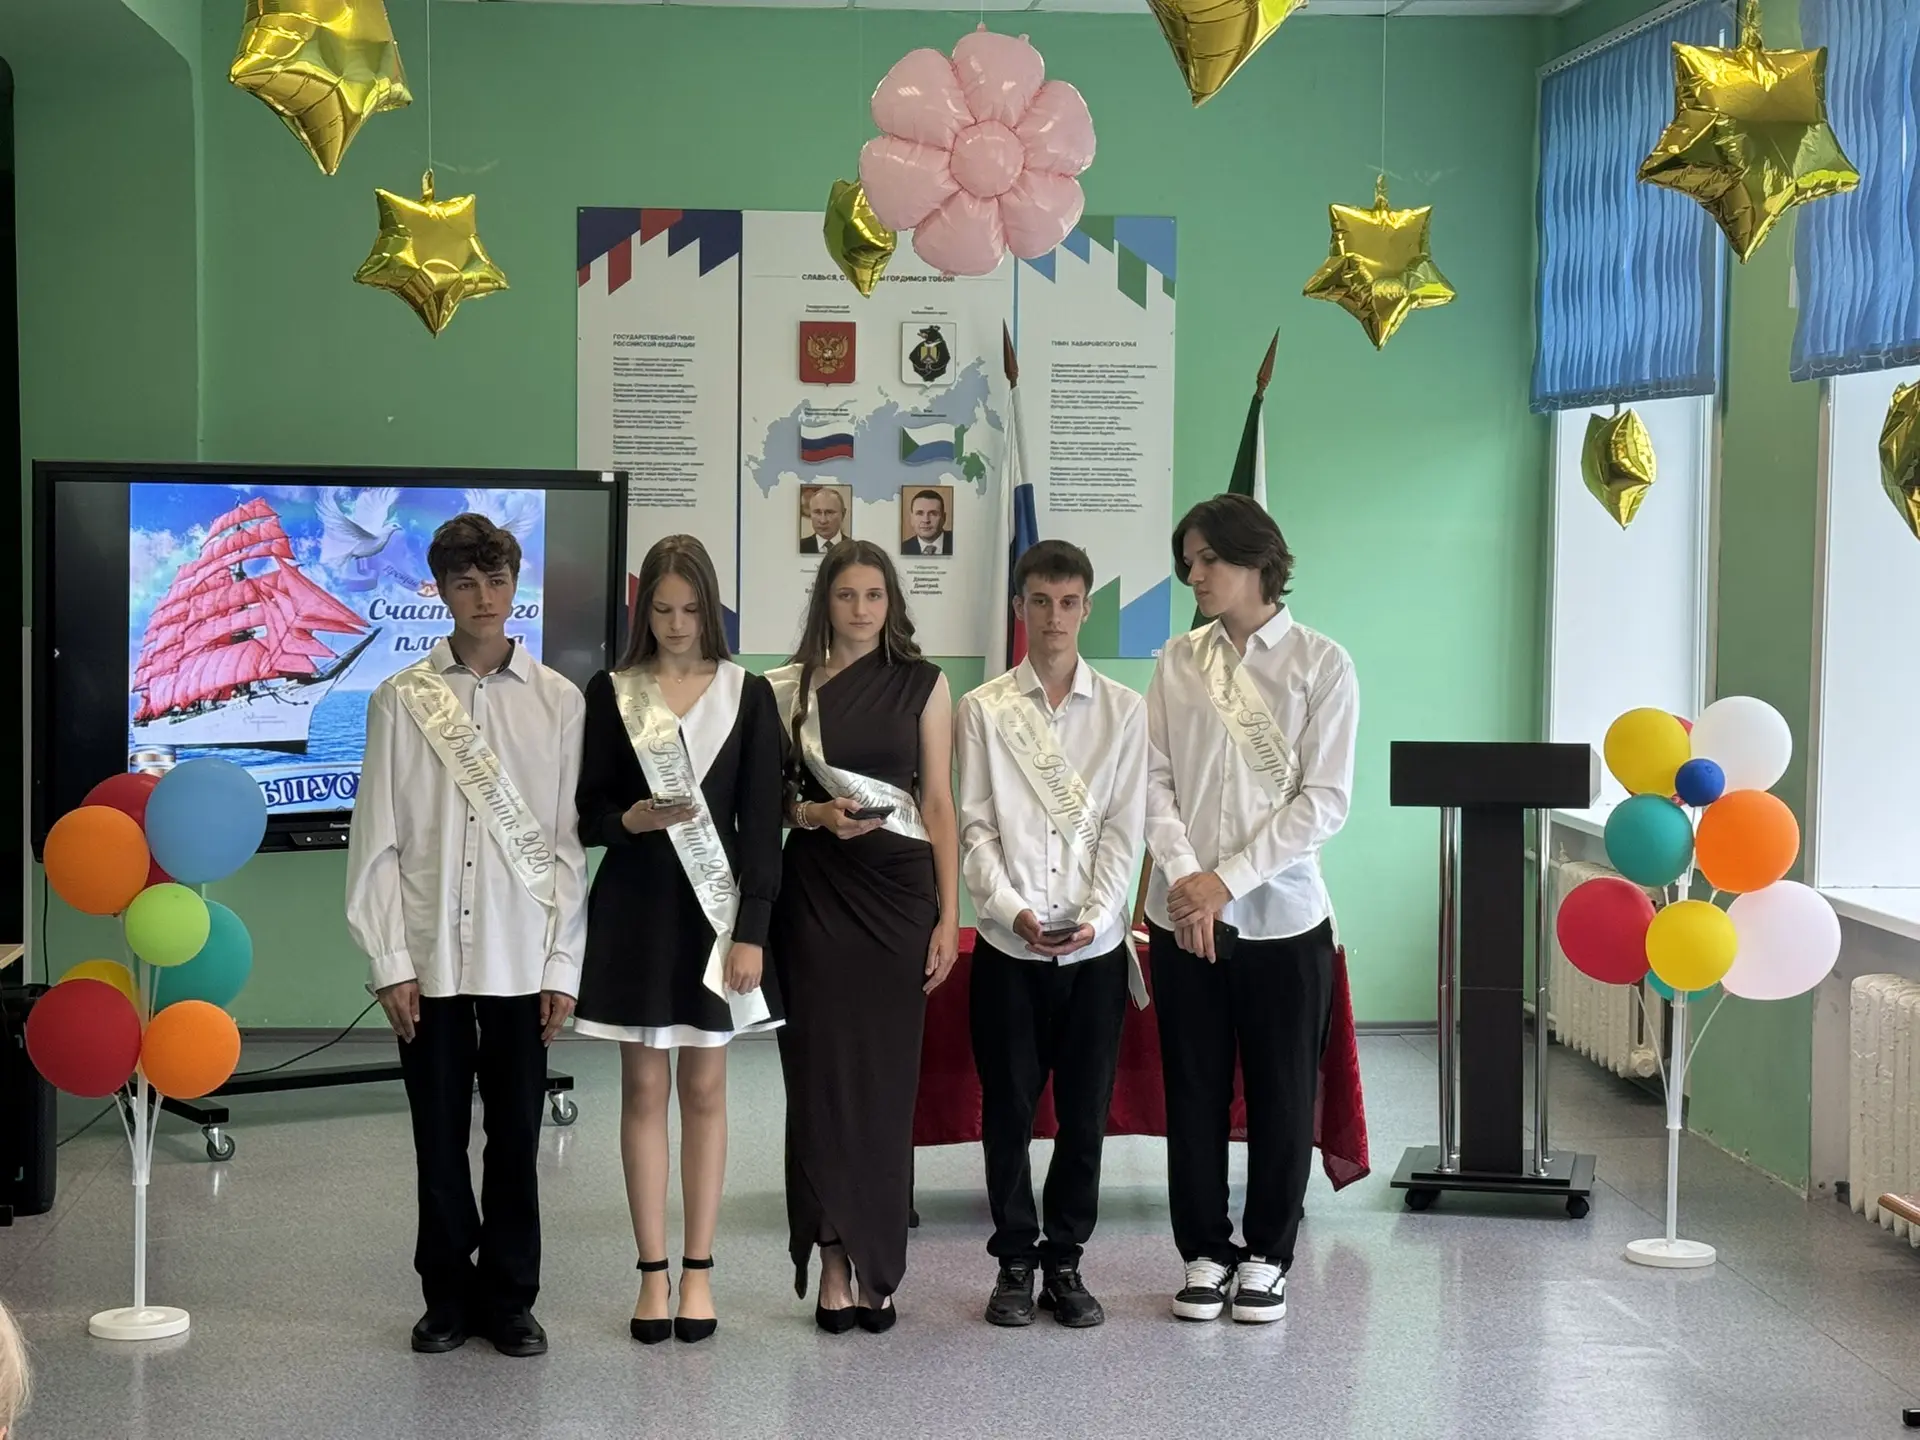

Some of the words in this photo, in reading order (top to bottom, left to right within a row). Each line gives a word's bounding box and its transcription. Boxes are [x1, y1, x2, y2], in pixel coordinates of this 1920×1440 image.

[801, 273, 838, 282] СЛАВЬСЯ,
[886, 275, 927, 283] ГОРДИМСЯ
[369, 598, 540, 620] Счастго
[257, 771, 361, 808] ЫПУС
[439, 722, 520, 833] Выпускник
[513, 830, 556, 874] 2026
[696, 858, 737, 903] 2026
